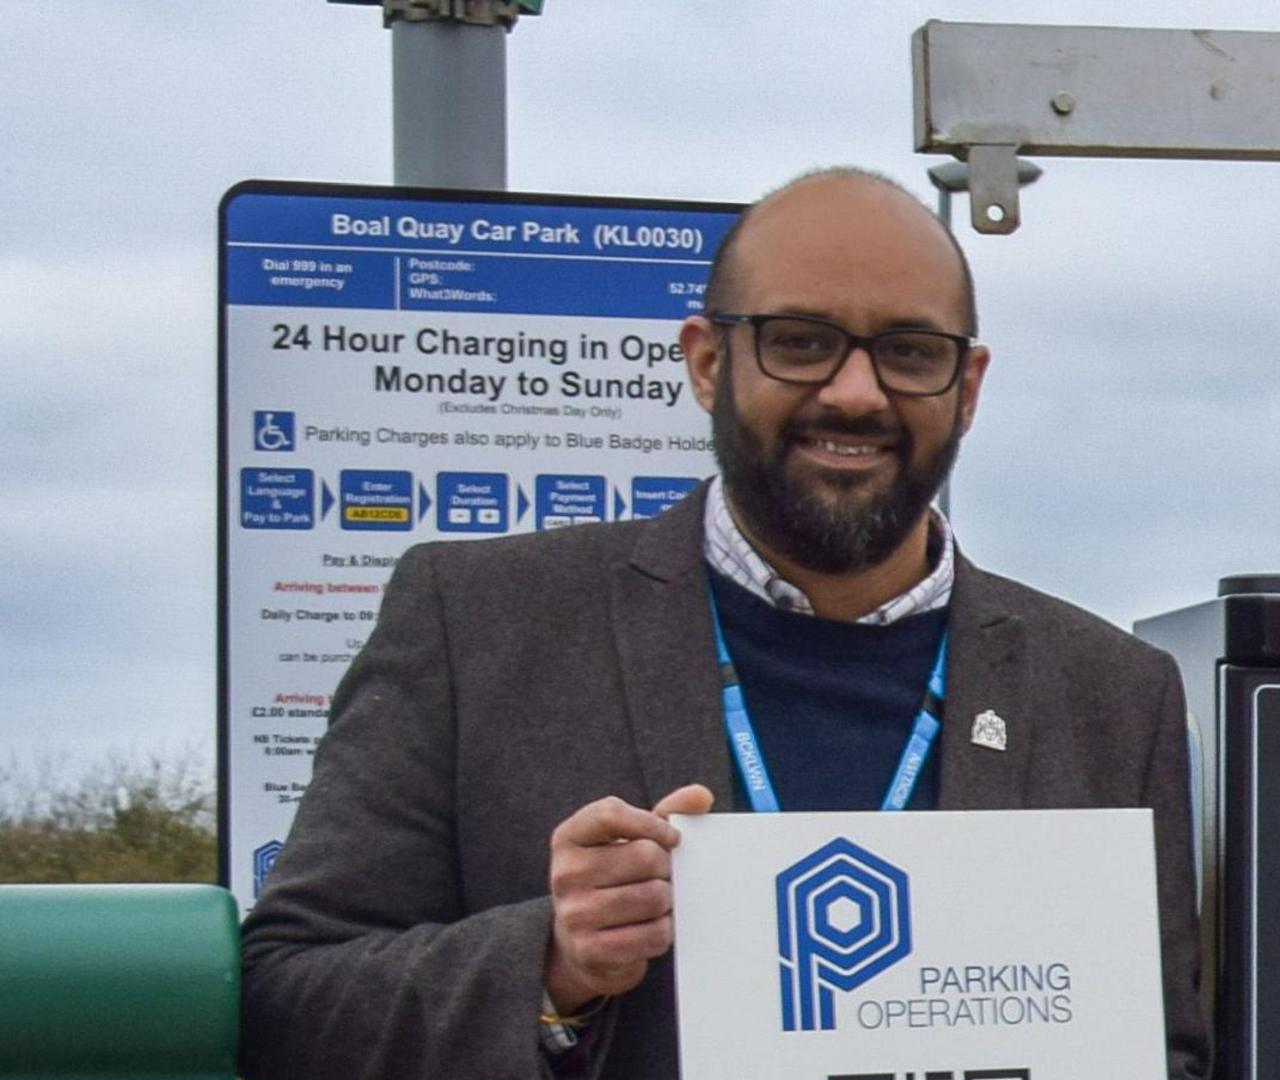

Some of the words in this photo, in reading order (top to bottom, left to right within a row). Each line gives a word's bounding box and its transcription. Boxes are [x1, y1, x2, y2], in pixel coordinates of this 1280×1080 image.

[332, 213, 390, 237] Boal
[397, 216, 464, 244] Quay
[471, 219, 516, 242] Car
[523, 221, 579, 244] Park
[593, 224, 703, 253] (KL0030)
[263, 258, 289, 271] Dial
[293, 260, 316, 272] 999
[320, 261, 333, 272] in
[336, 263, 352, 273] an
[409, 257, 475, 272] Postcode:
[271, 276, 345, 291] emergency
[409, 272, 443, 285] GPS:
[273, 323, 311, 350] 24
[323, 325, 405, 353] Hour
[416, 328, 568, 365] Charging
[580, 333, 608, 360] in
[620, 335, 684, 367] Ope
[375, 365, 506, 402] Monday
[518, 371, 549, 396] to
[560, 371, 684, 407] Sunday
[502, 403, 559, 417] Christmas
[563, 405, 587, 418] Day
[305, 426, 371, 446] Parking
[377, 427, 448, 447] Charges
[454, 431, 489, 446] also
[494, 433, 540, 450] apply
[545, 434, 561, 447] to
[566, 433, 604, 449] Blue
[609, 434, 663, 453] Badge
[668, 436, 716, 451] Holde
[257, 472, 296, 483] Select
[244, 511, 265, 525] Pay
[274, 581, 324, 595] Arriving
[261, 608, 292, 622] Daily
[296, 610, 340, 622] Charge
[344, 611, 356, 621] to
[920, 963, 1071, 995] PARKING
[857, 995, 1072, 1030] OPERATIONS
